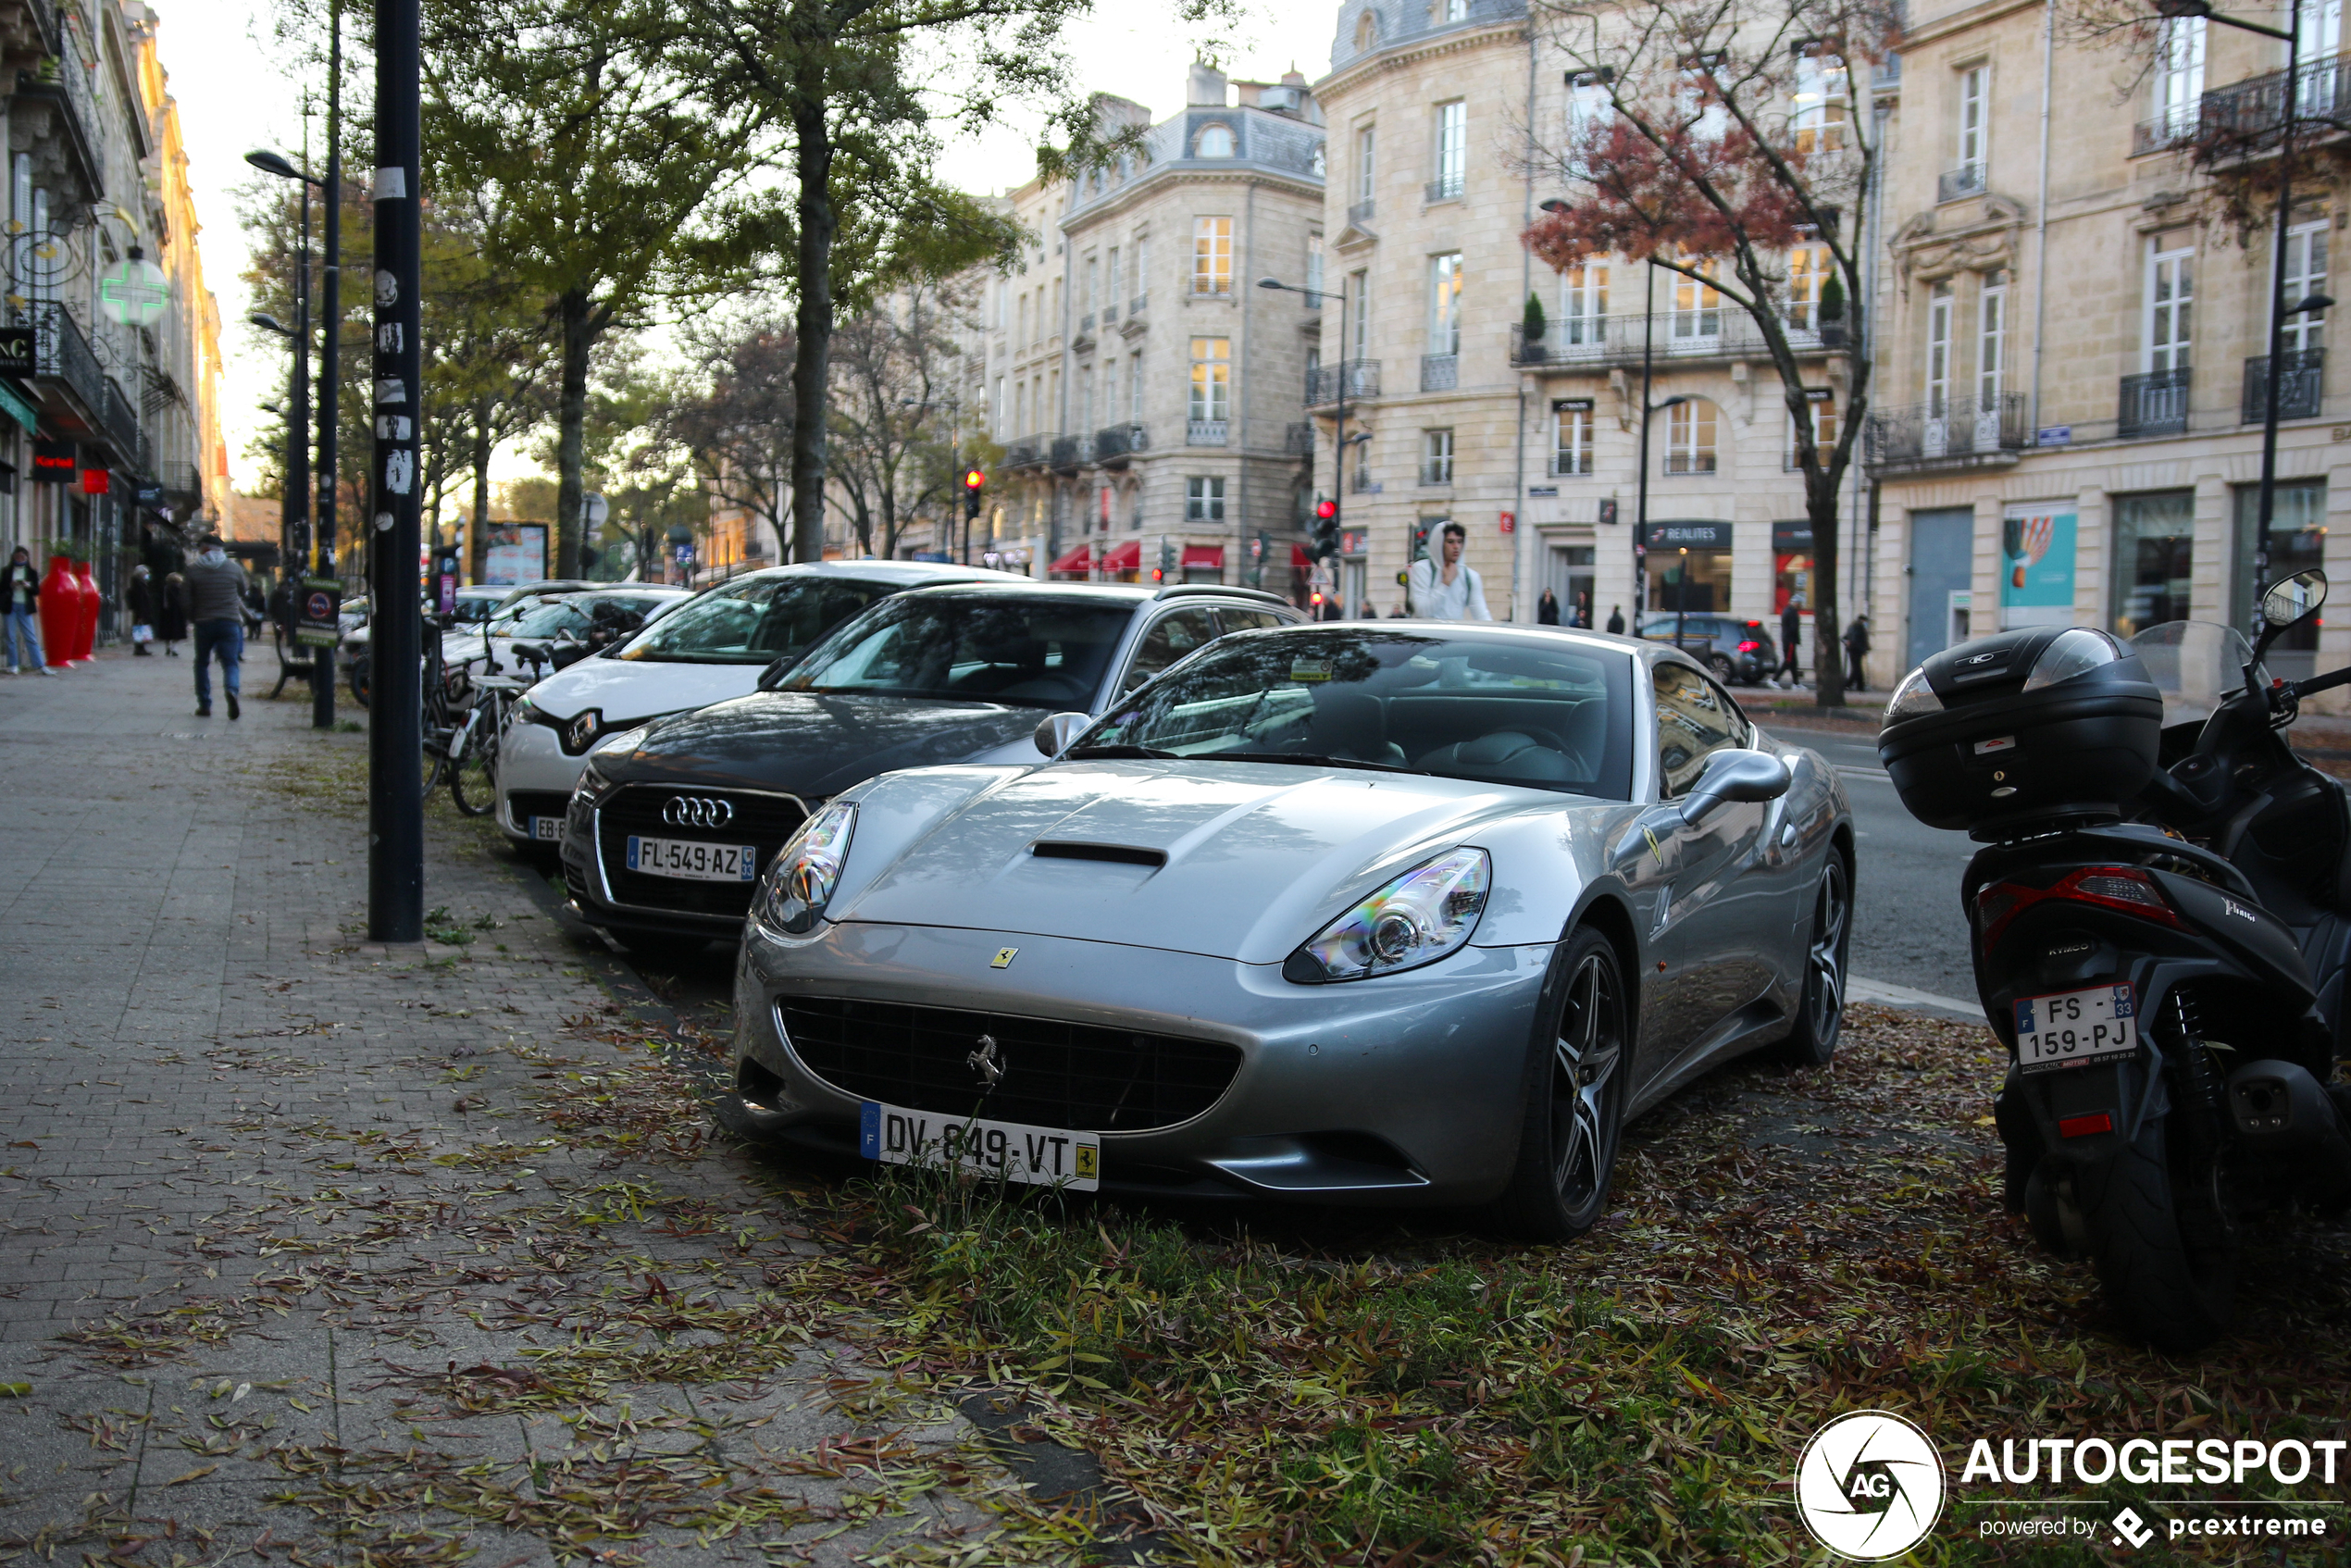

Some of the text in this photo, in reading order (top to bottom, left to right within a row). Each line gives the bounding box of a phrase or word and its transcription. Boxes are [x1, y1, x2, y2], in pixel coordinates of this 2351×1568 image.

[641, 841, 739, 875] FL-549-AZ
[741, 864, 753, 877] 33
[2048, 943, 2089, 956] KYMCO
[2116, 1002, 2132, 1015] 33
[2022, 1019, 2028, 1028] F
[2030, 1021, 2126, 1058] 159-PJ
[2022, 1062, 2061, 1073] BORDEAUX
[2062, 1059, 2087, 1067] MOTOS
[866, 1114, 1070, 1176] F DV-849-VT
